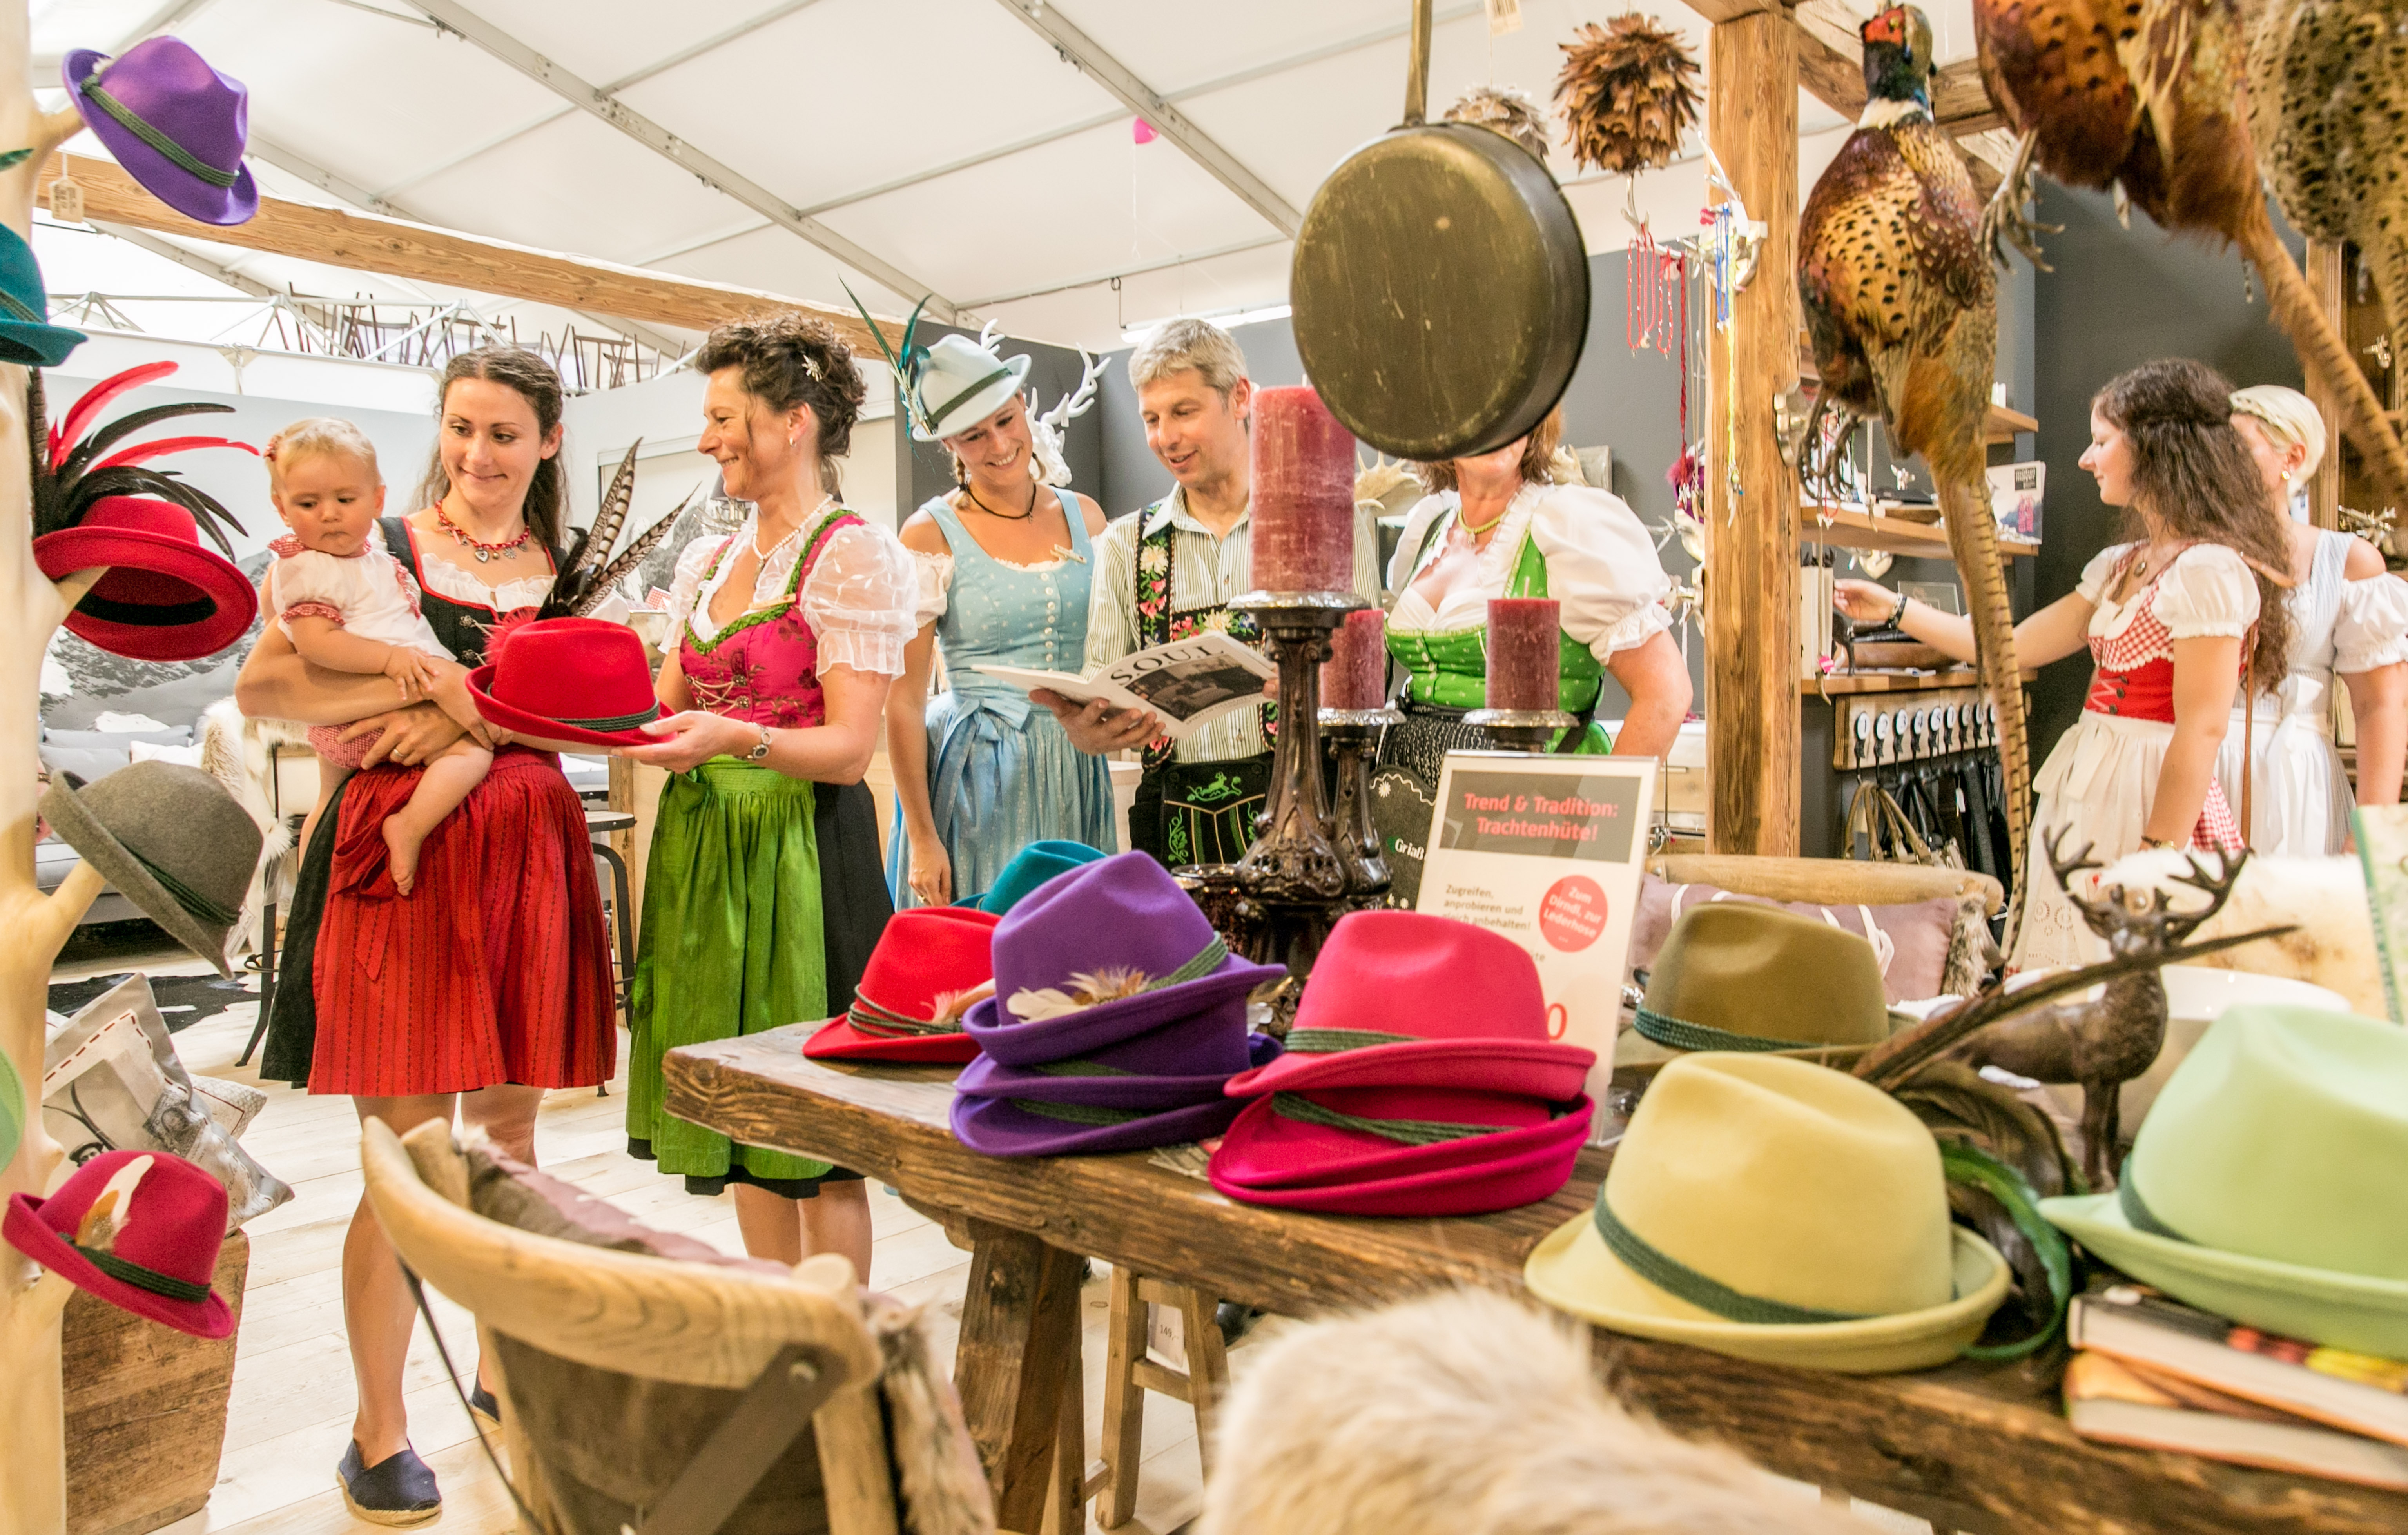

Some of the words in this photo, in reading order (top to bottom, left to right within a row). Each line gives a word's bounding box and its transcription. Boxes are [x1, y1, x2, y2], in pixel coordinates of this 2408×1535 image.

[1464, 793, 1510, 812] Trend
[1514, 795, 1528, 813] &
[1534, 796, 1619, 818] Tradition:
[1477, 816, 1599, 842] Trachtenhüte!
[1395, 838, 1425, 860] Griaß
[1446, 884, 1494, 899] Zugreifen,
[1568, 886, 1592, 905] Zum
[1444, 900, 1502, 913] anprobieren
[1505, 905, 1524, 915] und
[1549, 894, 1582, 918] Dirndl,
[1584, 911, 1602, 924] zur
[1472, 916, 1531, 930] anbehalten!
[1543, 907, 1597, 939] Lederhose
